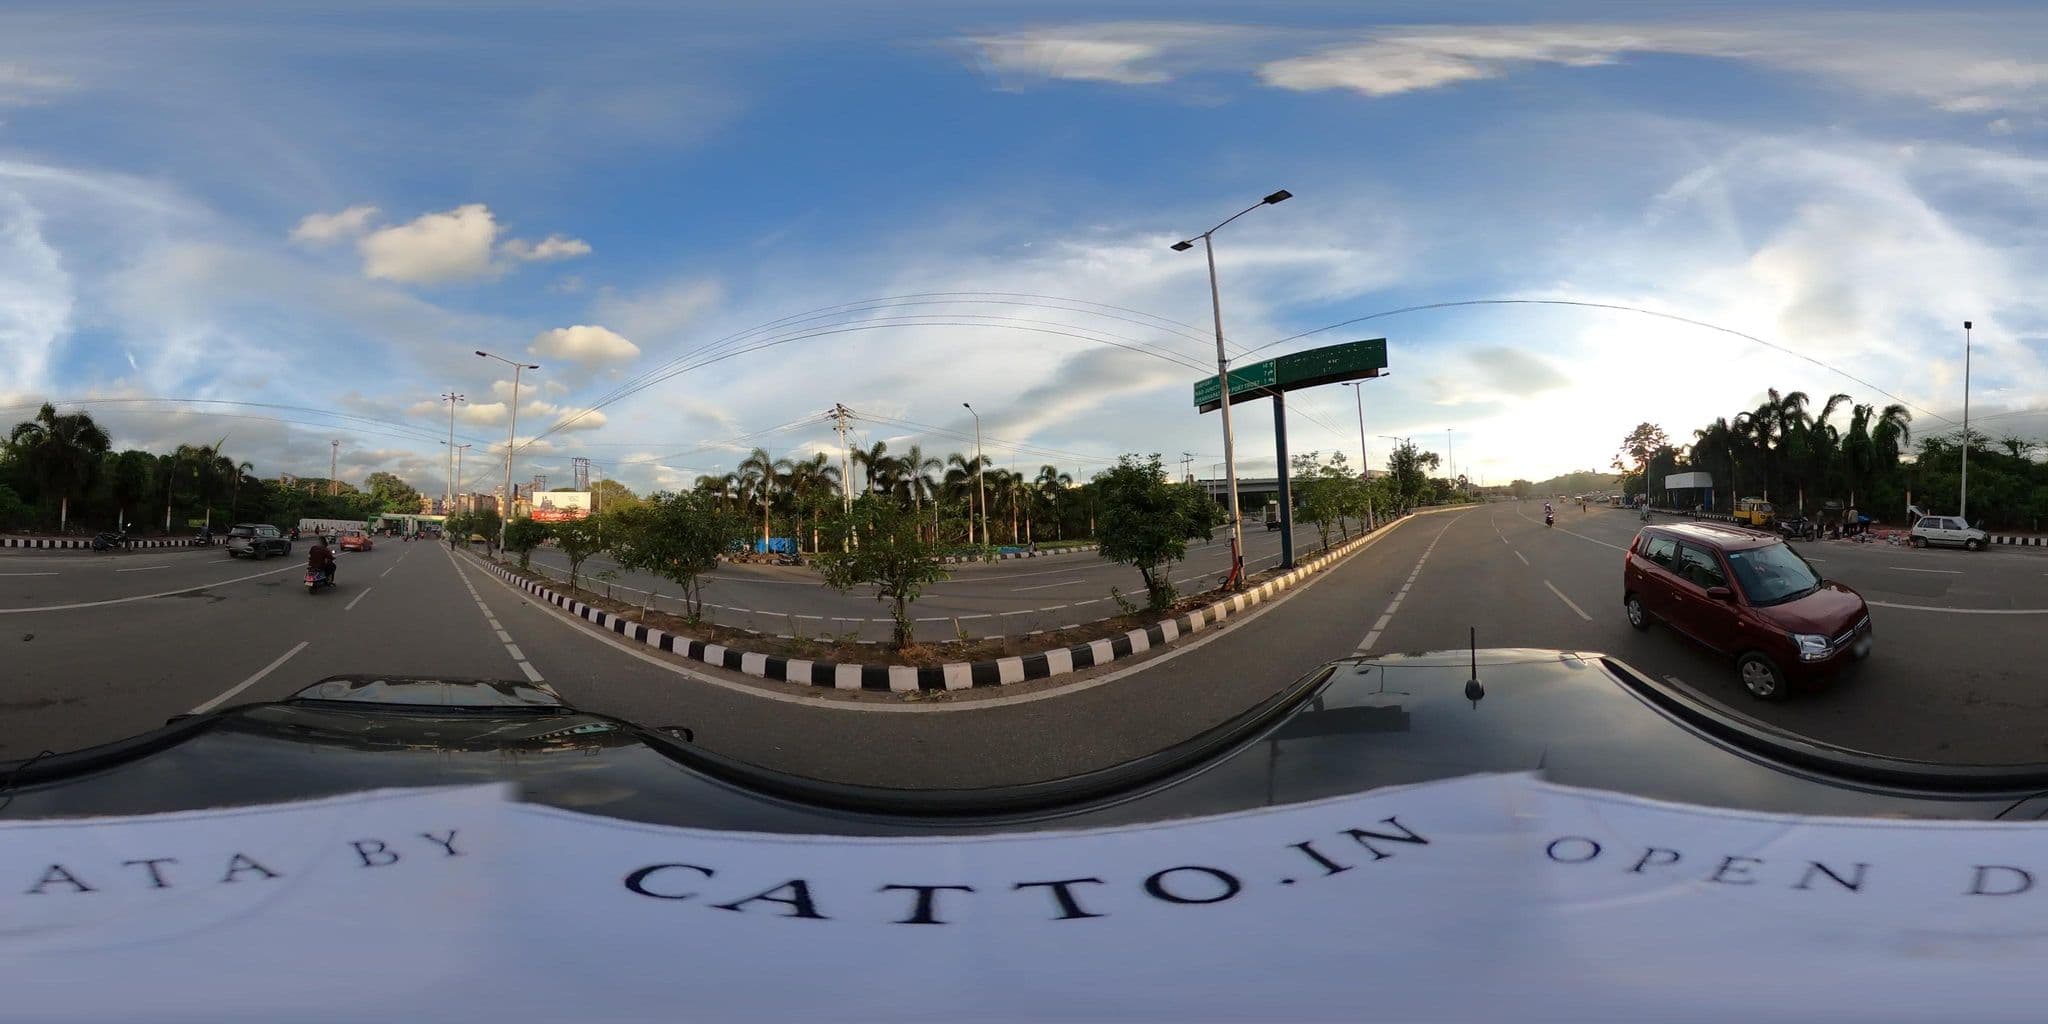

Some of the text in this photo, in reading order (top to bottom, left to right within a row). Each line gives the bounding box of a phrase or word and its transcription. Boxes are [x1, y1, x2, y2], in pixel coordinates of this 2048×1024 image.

[24, 829, 465, 895] ATA BY
[620, 815, 1432, 926] CATTO.IN
[1543, 835, 2038, 897] OPEN D
